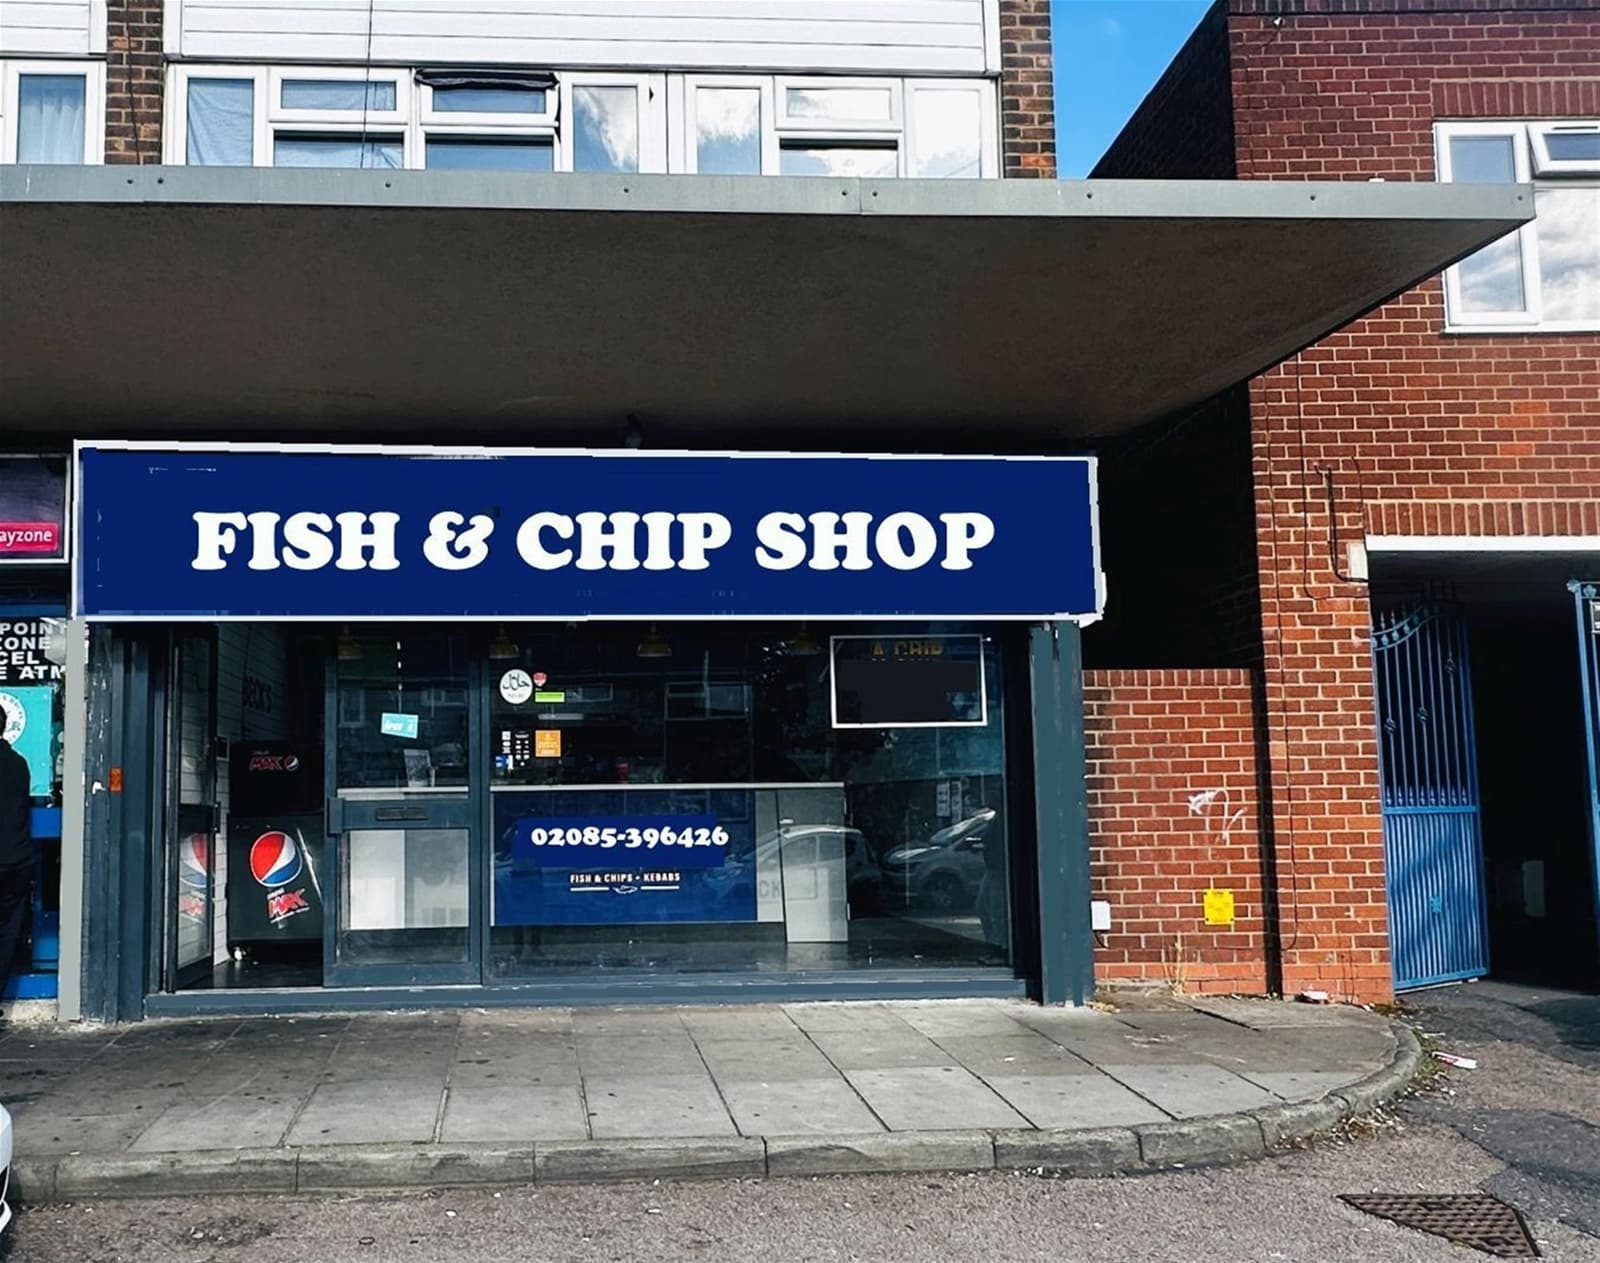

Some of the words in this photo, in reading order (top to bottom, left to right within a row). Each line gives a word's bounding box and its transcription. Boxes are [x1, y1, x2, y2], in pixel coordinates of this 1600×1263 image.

[191, 511, 401, 571] FISH
[422, 510, 495, 571] &
[516, 511, 732, 571] CHIP
[755, 511, 995, 571] SHOP
[0, 637, 51, 650] ONE
[530, 825, 729, 848] 02085-396426
[570, 873, 592, 883] FISH
[604, 873, 633, 883] CHIPS
[643, 872, 681, 882] KEBABS
